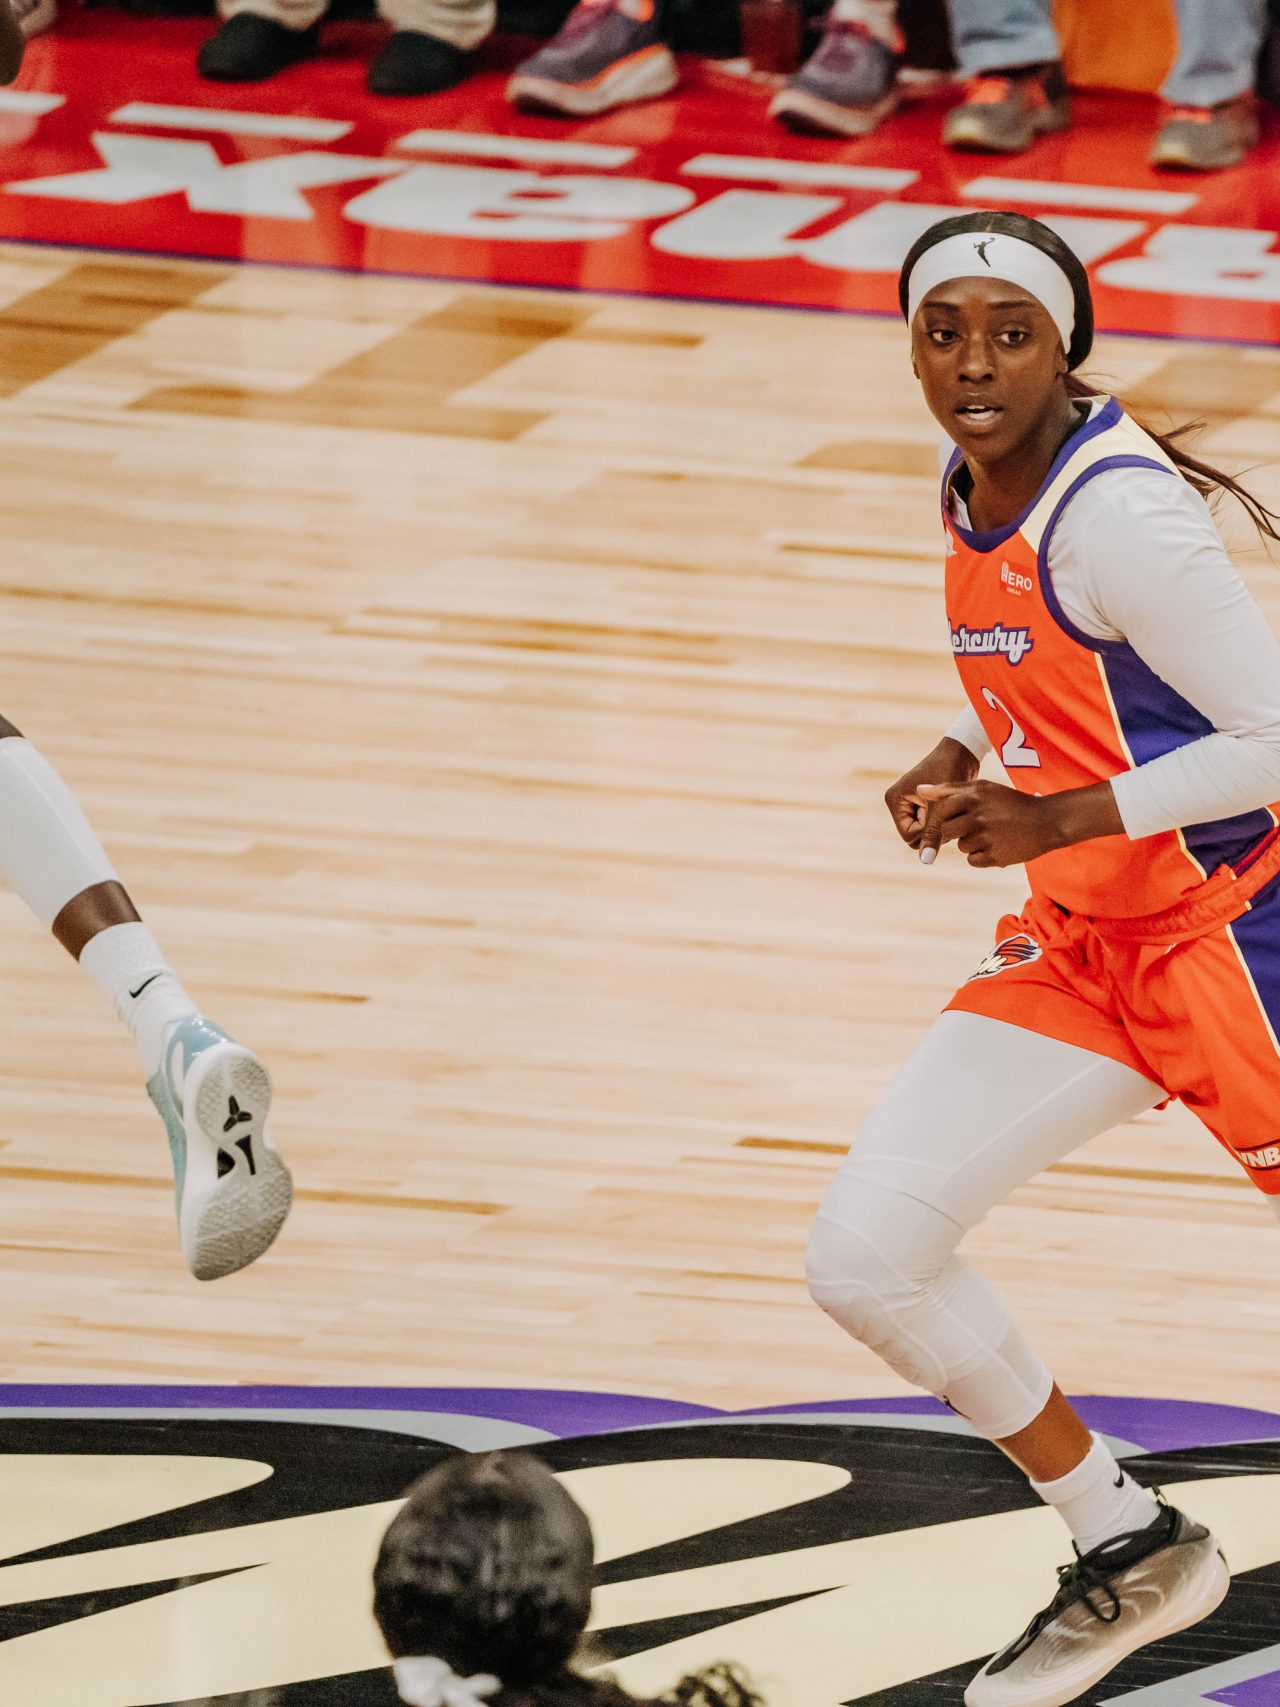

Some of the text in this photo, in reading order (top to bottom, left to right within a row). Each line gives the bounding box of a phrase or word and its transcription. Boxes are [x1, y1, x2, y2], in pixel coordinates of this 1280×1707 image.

[1001, 561, 1033, 591] HERO
[949, 619, 1034, 665] ercury
[981, 686, 1041, 768] 2
